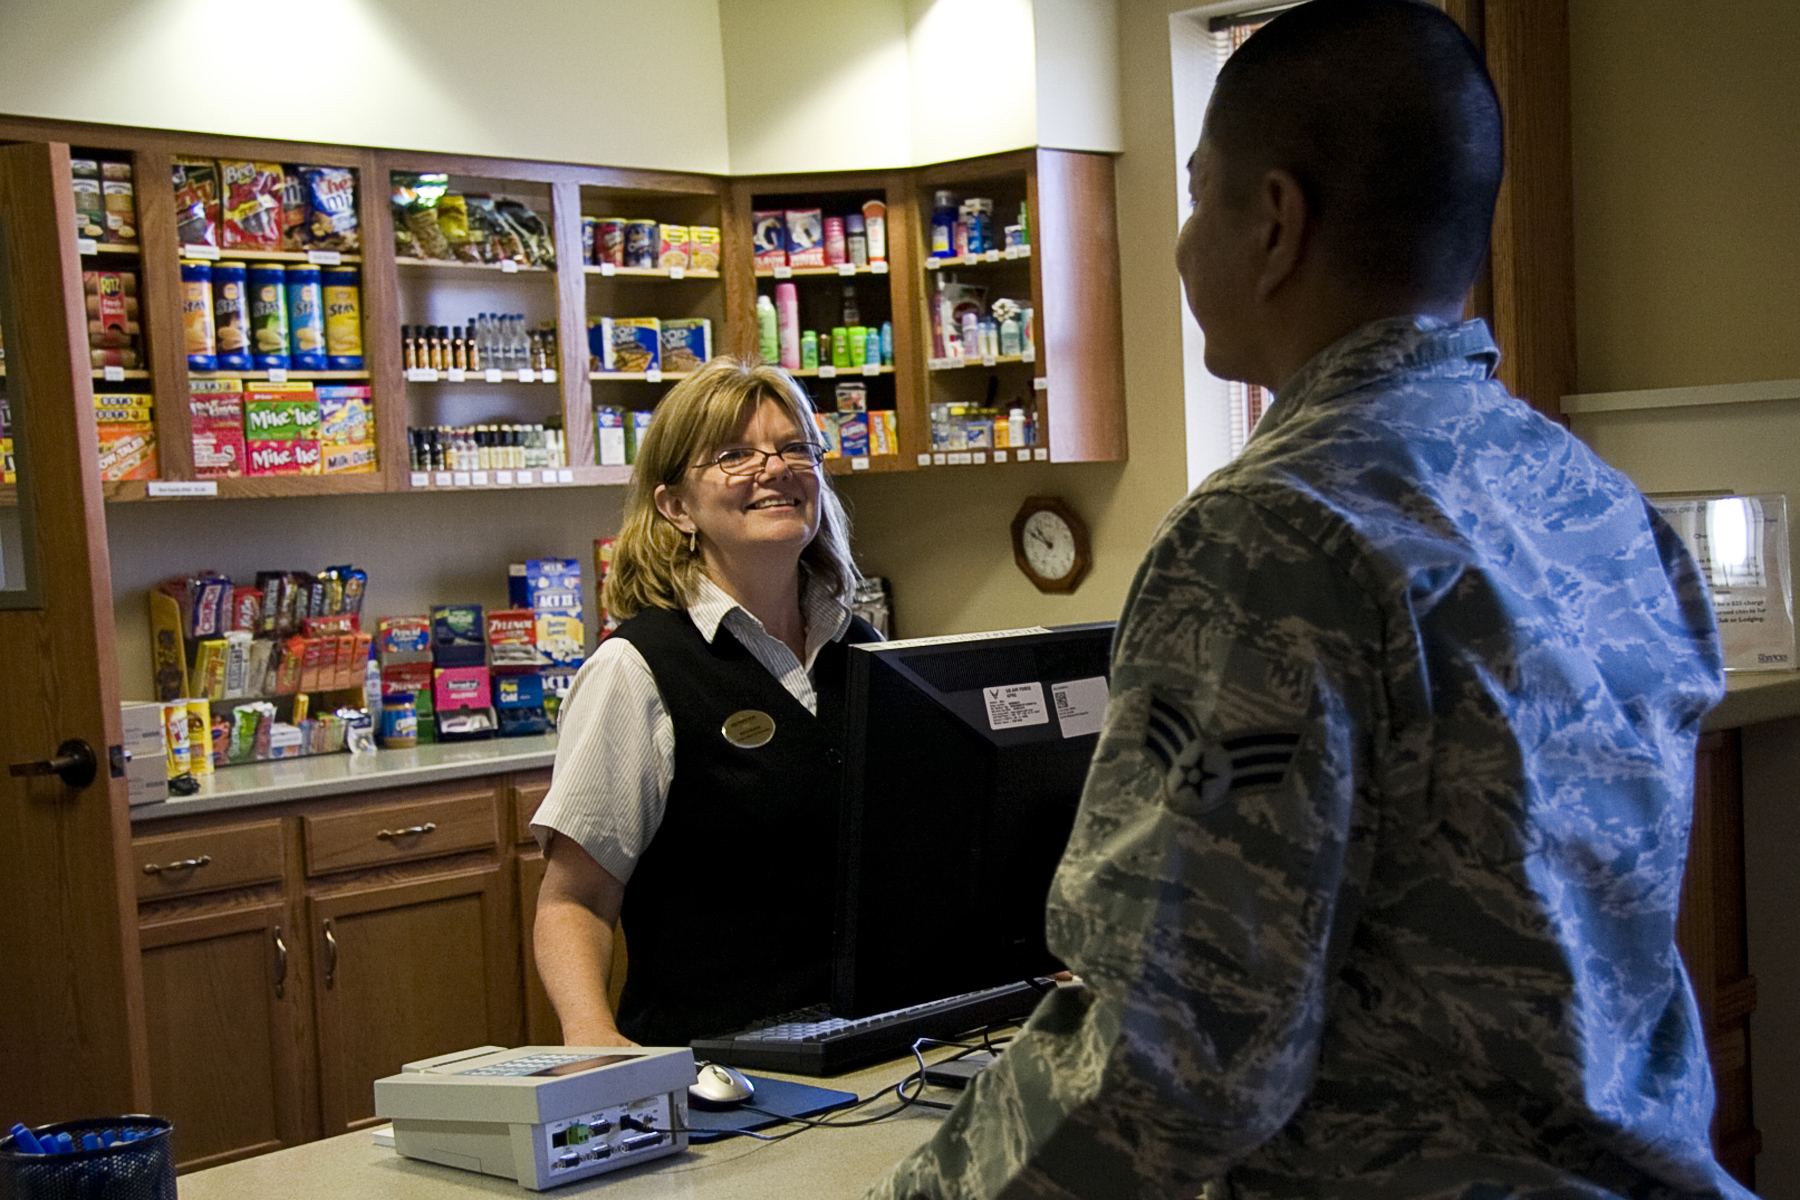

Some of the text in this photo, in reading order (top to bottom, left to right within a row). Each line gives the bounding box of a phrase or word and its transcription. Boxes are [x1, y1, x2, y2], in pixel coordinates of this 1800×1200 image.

[326, 192, 354, 212] mi
[249, 409, 291, 431] Mike
[295, 407, 320, 426] Ike
[251, 448, 293, 471] Mike
[295, 445, 320, 465] Ike
[540, 595, 560, 608] ACT
